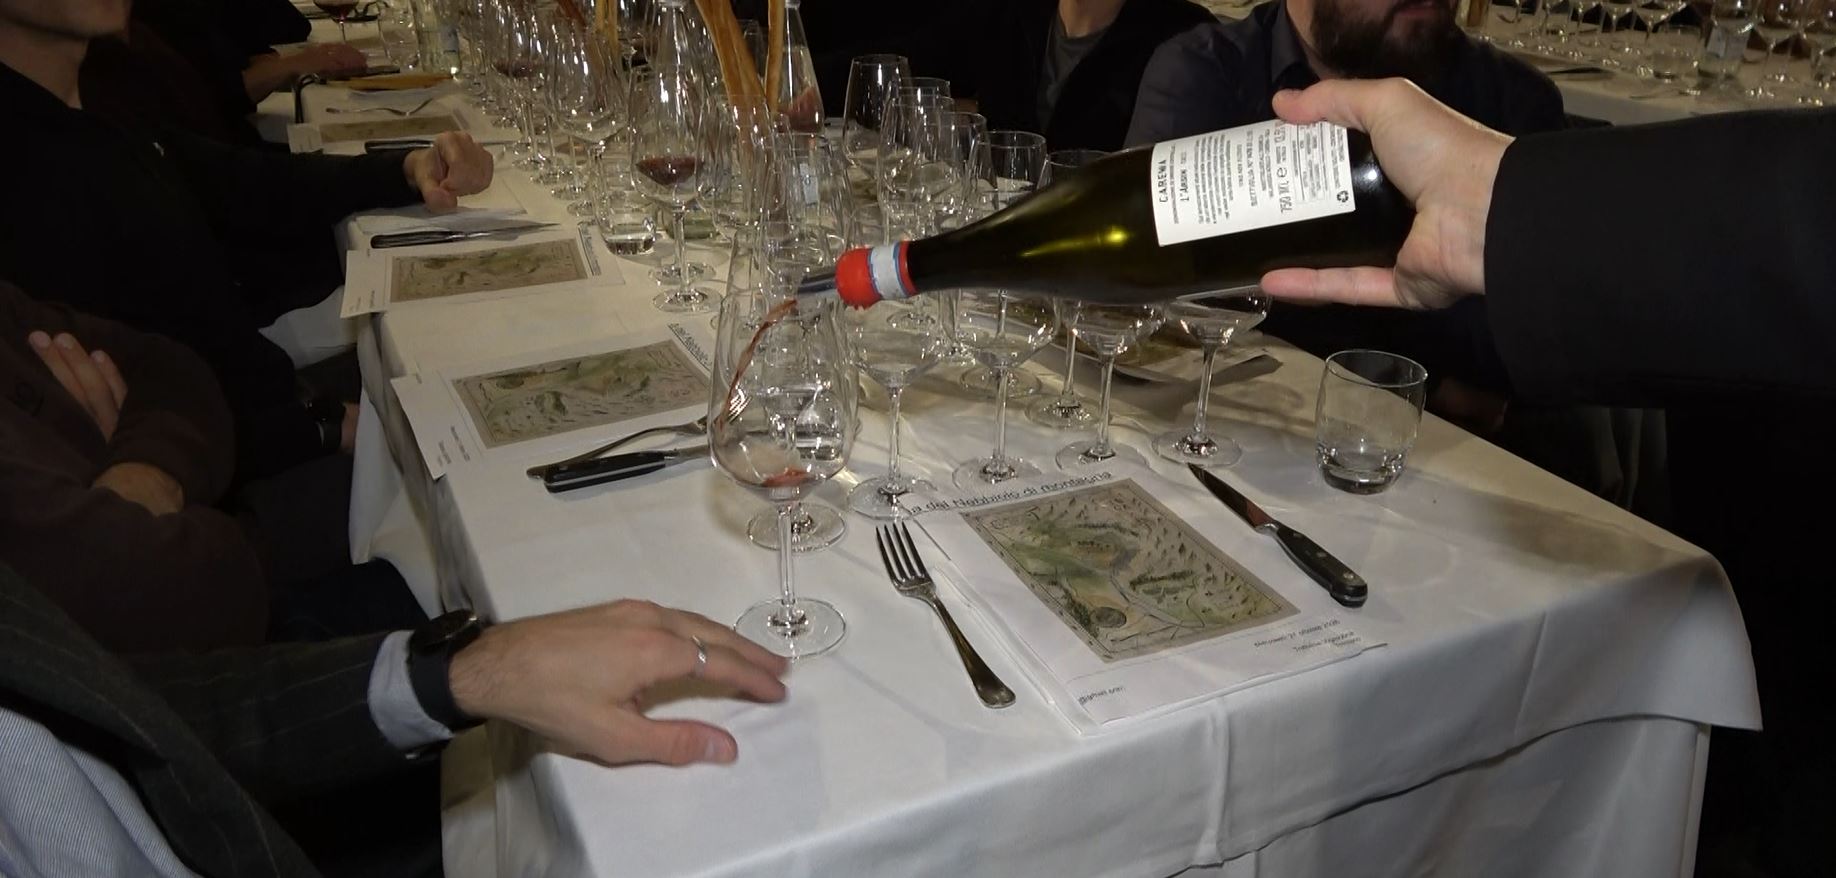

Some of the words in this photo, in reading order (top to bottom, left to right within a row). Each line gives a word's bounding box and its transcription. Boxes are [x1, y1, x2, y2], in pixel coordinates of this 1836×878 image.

[1157, 159, 1168, 203] CAREMA
[926, 501, 950, 511] del
[952, 492, 1019, 508] Nebbiolo
[1023, 487, 1038, 497] di
[1040, 472, 1111, 491] montagna
